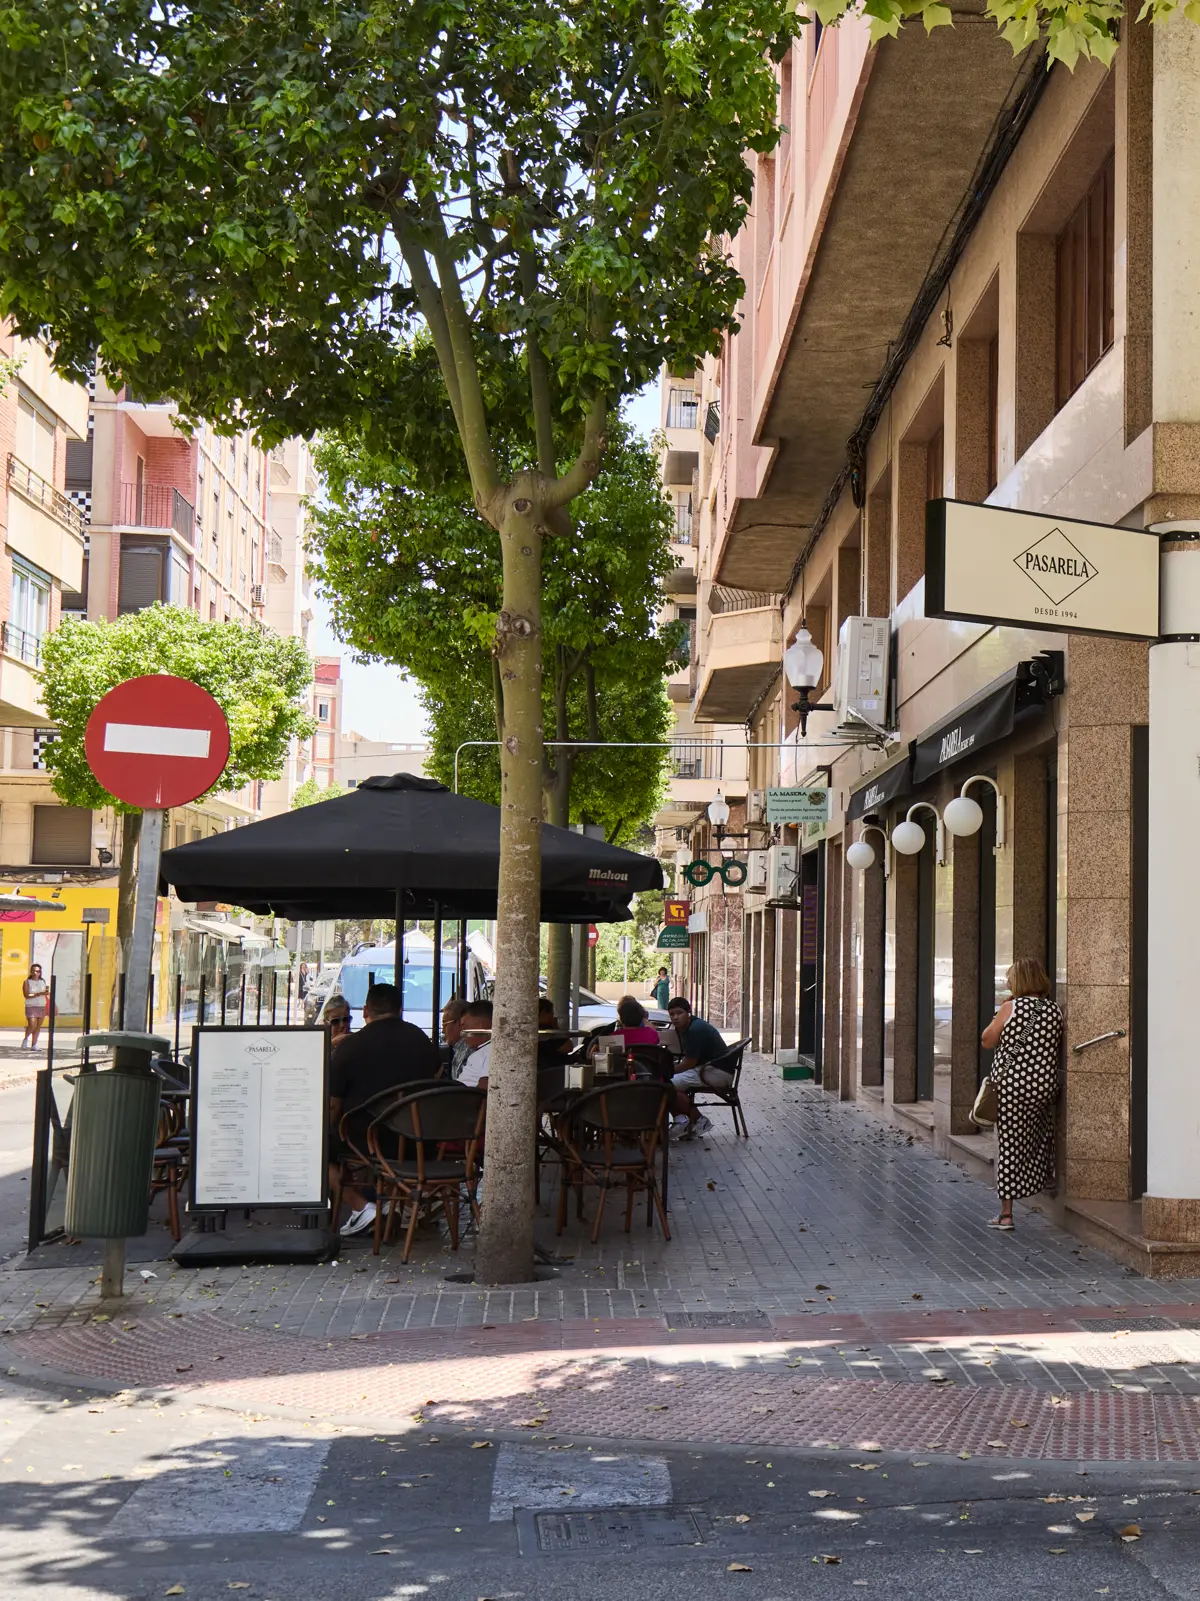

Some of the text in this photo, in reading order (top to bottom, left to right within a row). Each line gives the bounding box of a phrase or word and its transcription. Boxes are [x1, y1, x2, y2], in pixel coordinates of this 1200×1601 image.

[1025, 552, 1090, 578] PASARELA
[1034, 606, 1078, 619] DESDE 1994
[589, 868, 628, 880] Mahou
